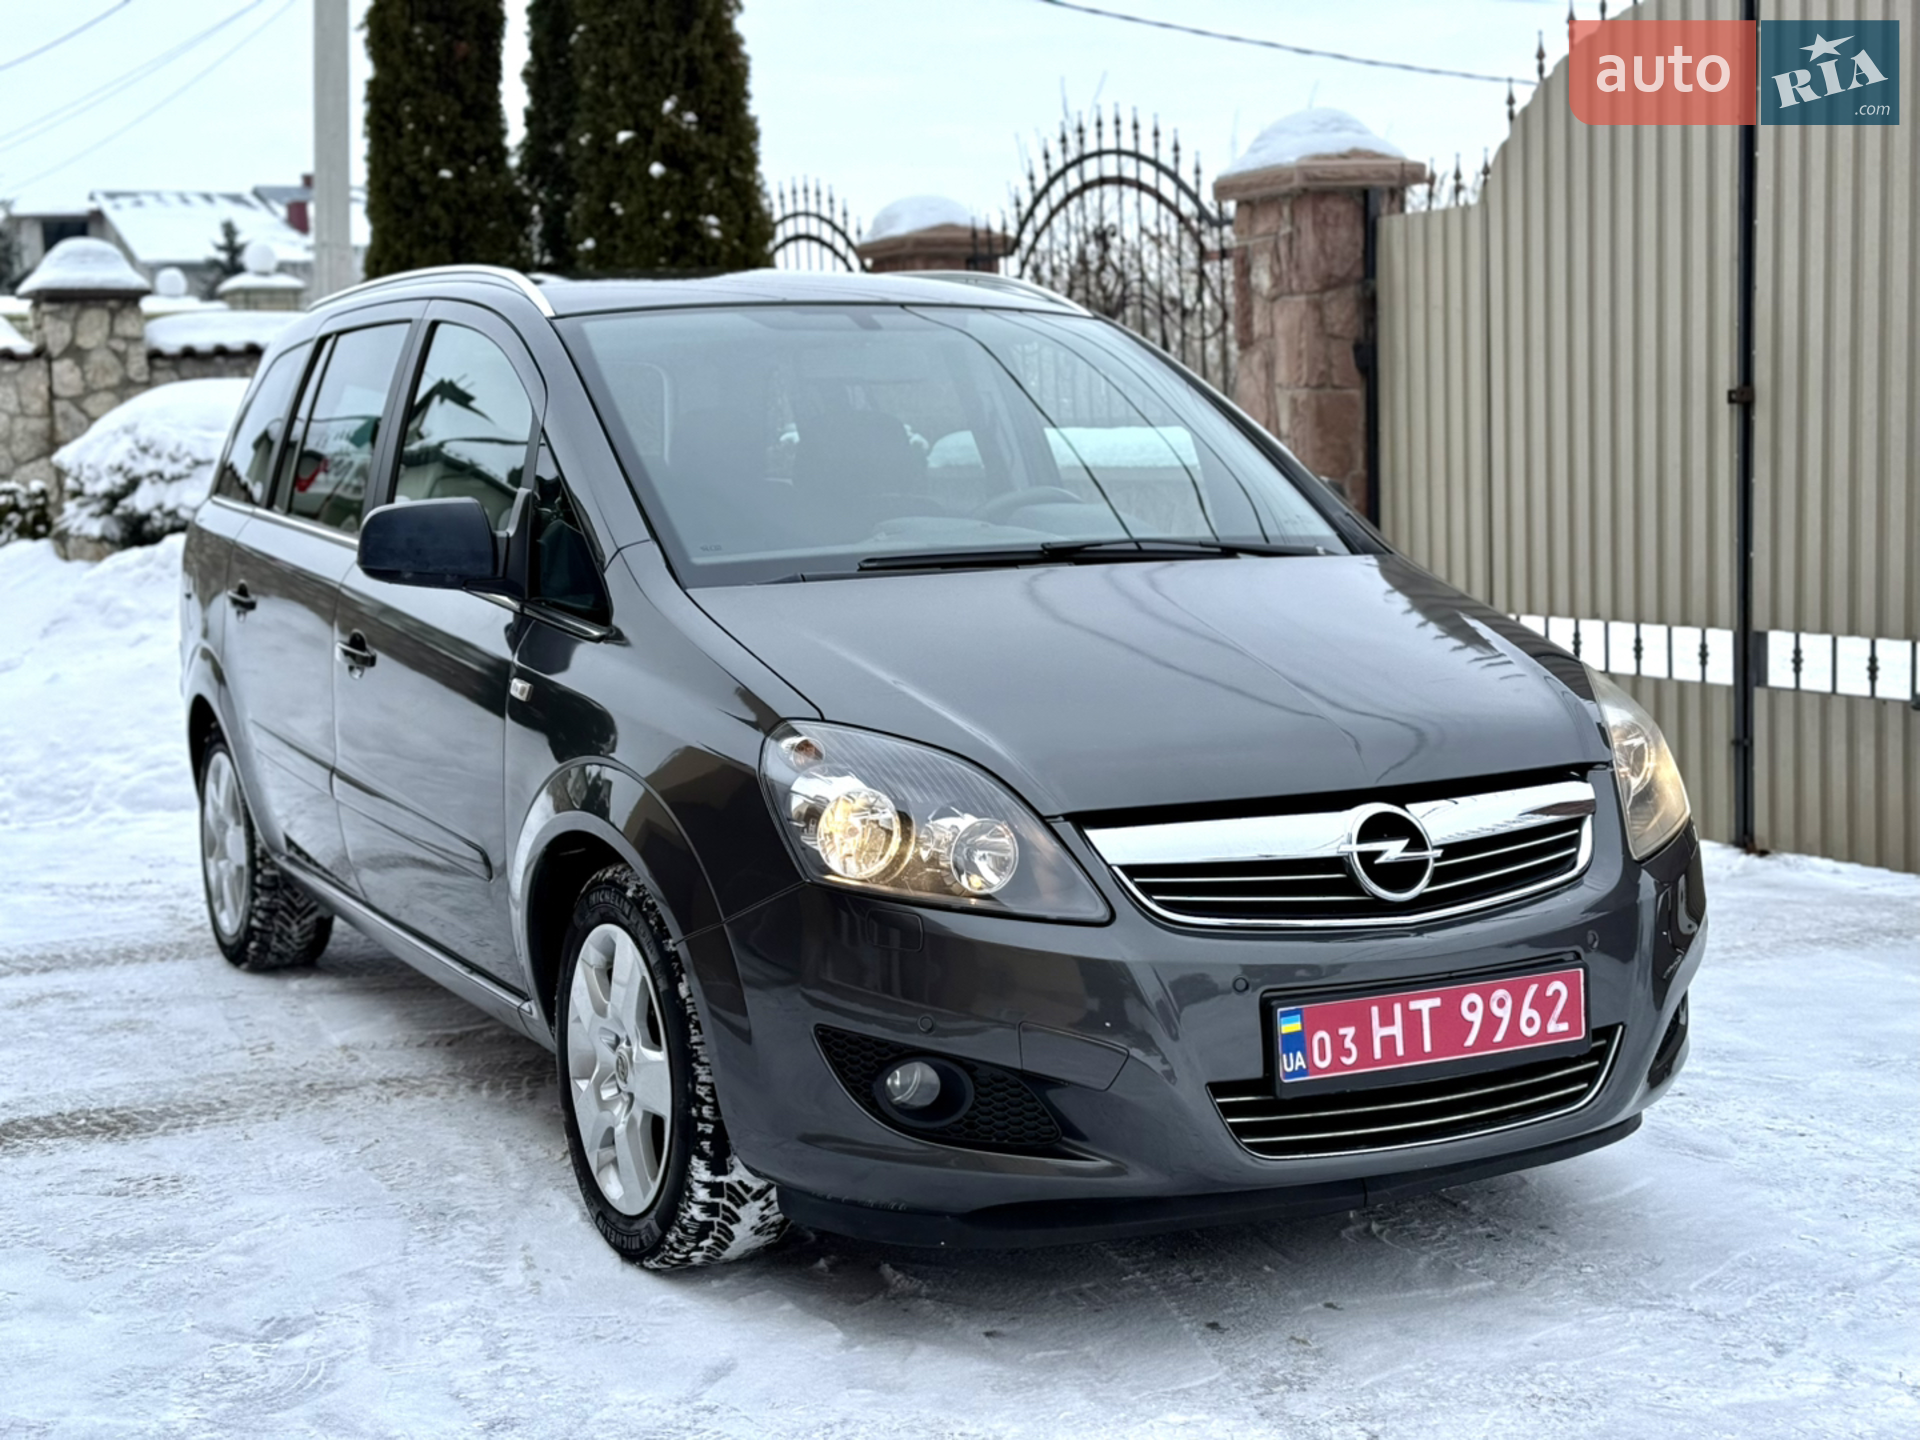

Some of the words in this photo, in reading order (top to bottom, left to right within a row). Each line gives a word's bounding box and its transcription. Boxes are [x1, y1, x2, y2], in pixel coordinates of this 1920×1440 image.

[589, 890, 631, 915] MICHELIN
[1311, 1026, 1358, 1069] 03
[1370, 998, 1441, 1060] HT
[1460, 980, 1569, 1047] 9962
[1283, 1051, 1307, 1072] UA
[597, 1215, 640, 1250] MICHELIN
